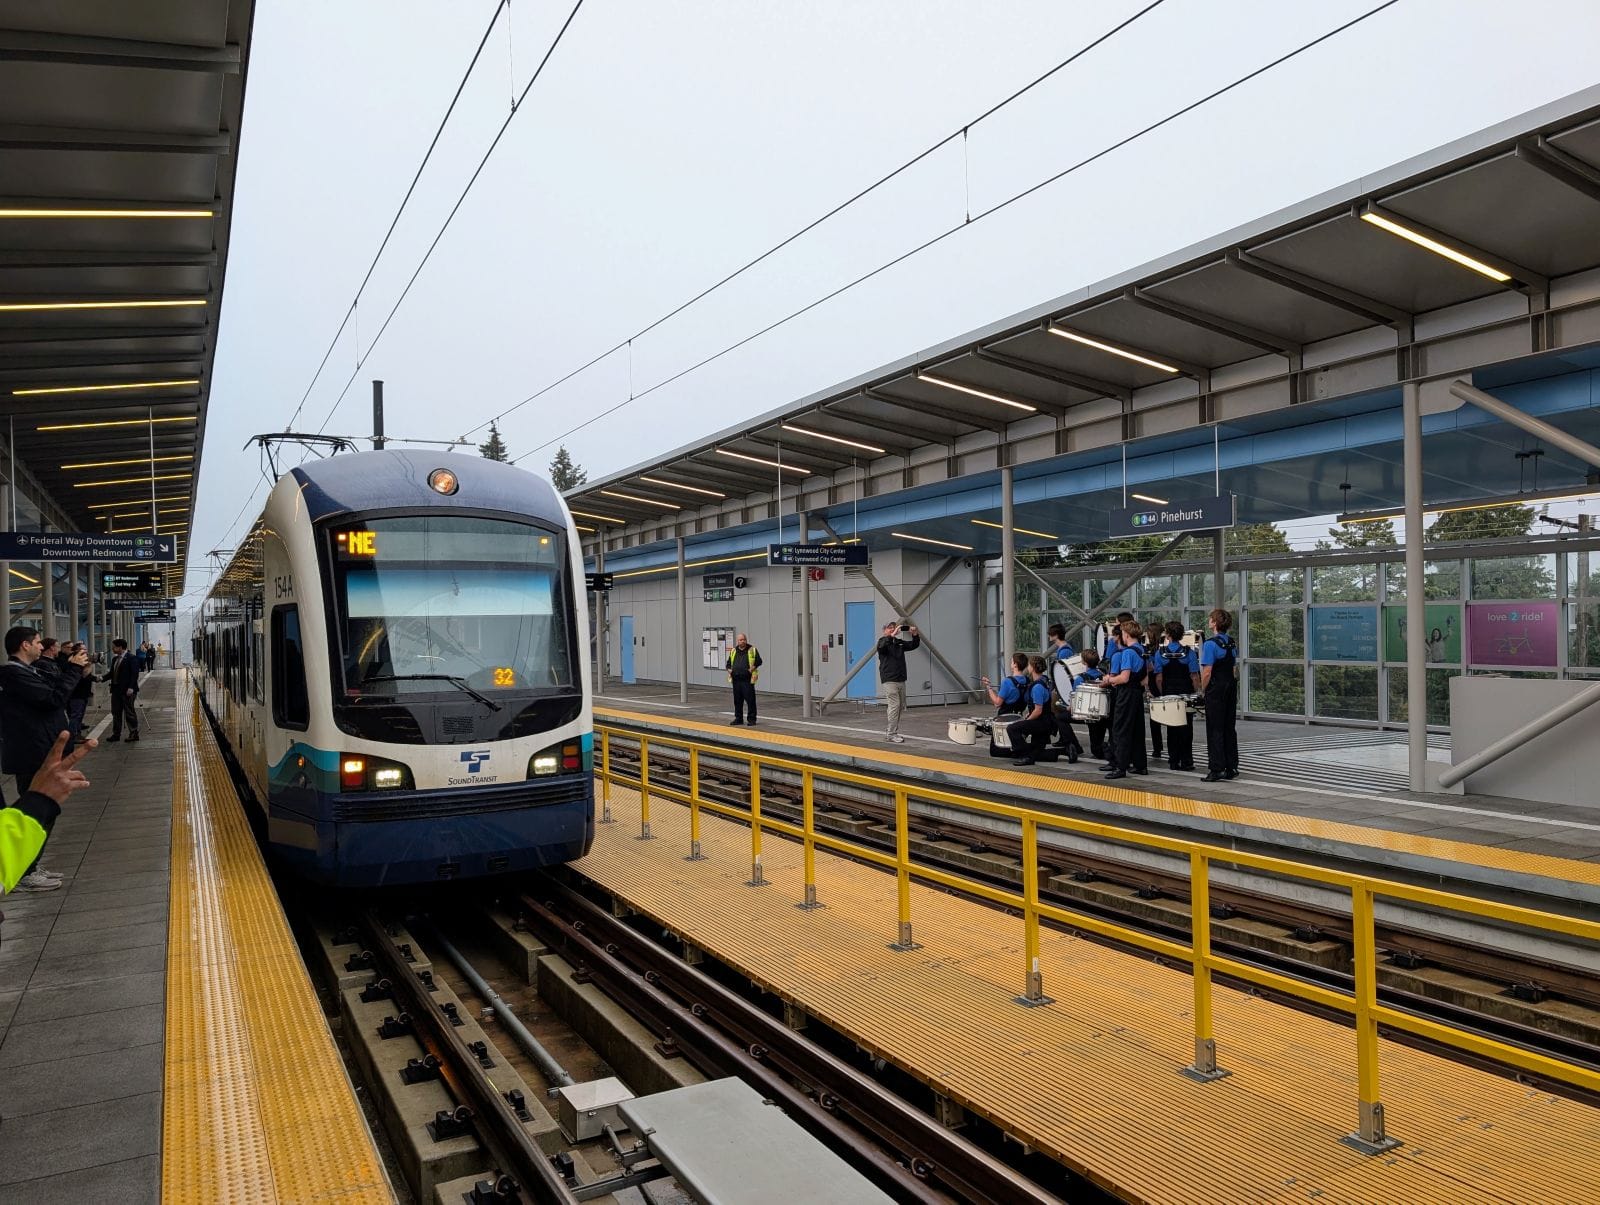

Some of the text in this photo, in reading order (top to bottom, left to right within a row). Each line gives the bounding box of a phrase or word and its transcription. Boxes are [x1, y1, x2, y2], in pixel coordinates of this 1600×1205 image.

[1147, 514, 1156, 523] 44
[1161, 508, 1203, 523] Pinehurst
[30, 536, 63, 545] Federal
[65, 537, 84, 546] Way
[86, 537, 133, 546] Downtown
[348, 531, 377, 554] NE
[42, 548, 90, 557] Downtown
[92, 548, 133, 557] Redmond
[794, 547, 819, 555] Lynnwood
[820, 547, 830, 555] City
[820, 556, 830, 564] City
[274, 574, 294, 599] 154A
[1487, 612, 1507, 621] love
[1521, 611, 1544, 621] ride!
[494, 667, 514, 686] 32
